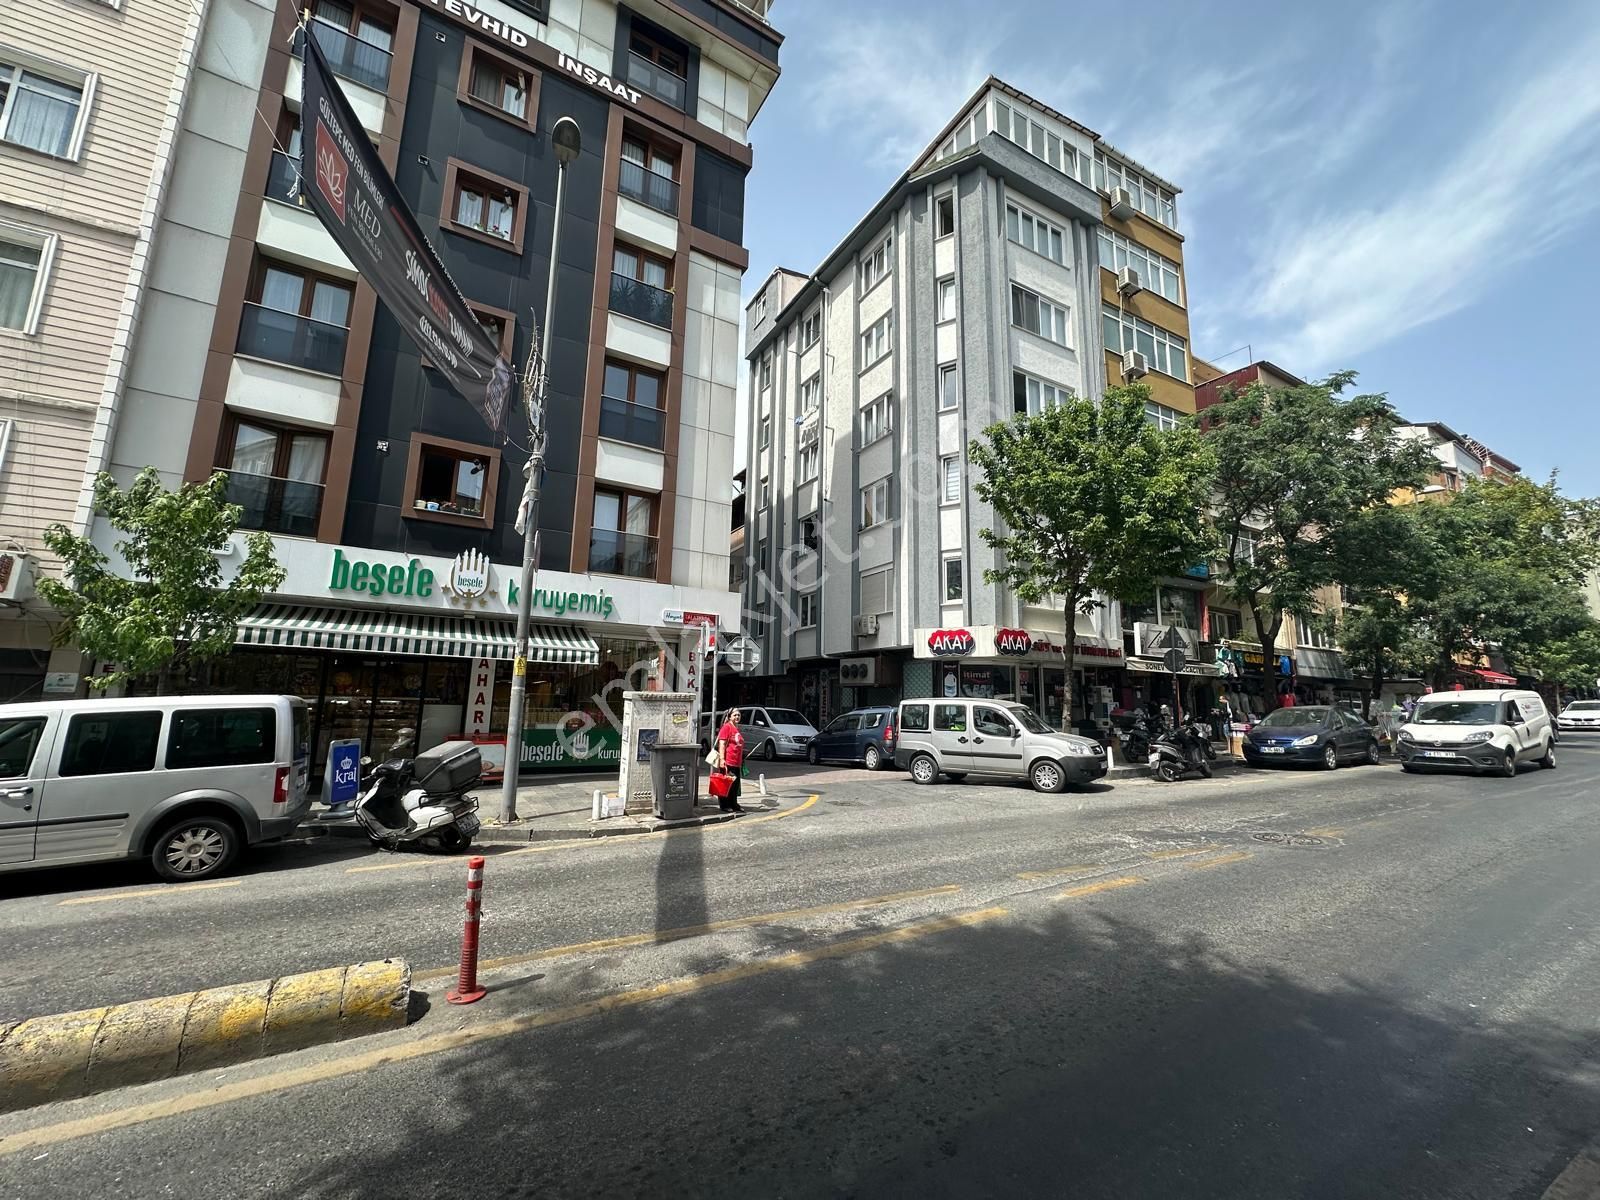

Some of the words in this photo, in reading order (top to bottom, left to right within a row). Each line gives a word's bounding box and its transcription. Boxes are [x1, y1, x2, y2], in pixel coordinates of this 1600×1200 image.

[431, 0, 528, 48] EVHİD
[557, 53, 641, 104] İNŞAAT
[353, 186, 381, 238] MED
[328, 548, 434, 597] beşefe
[507, 578, 614, 618] kruyemiş
[933, 634, 969, 650] AKAY
[1000, 634, 1028, 650] AKAY
[519, 740, 564, 763] beşefe
[335, 767, 357, 784] kral
